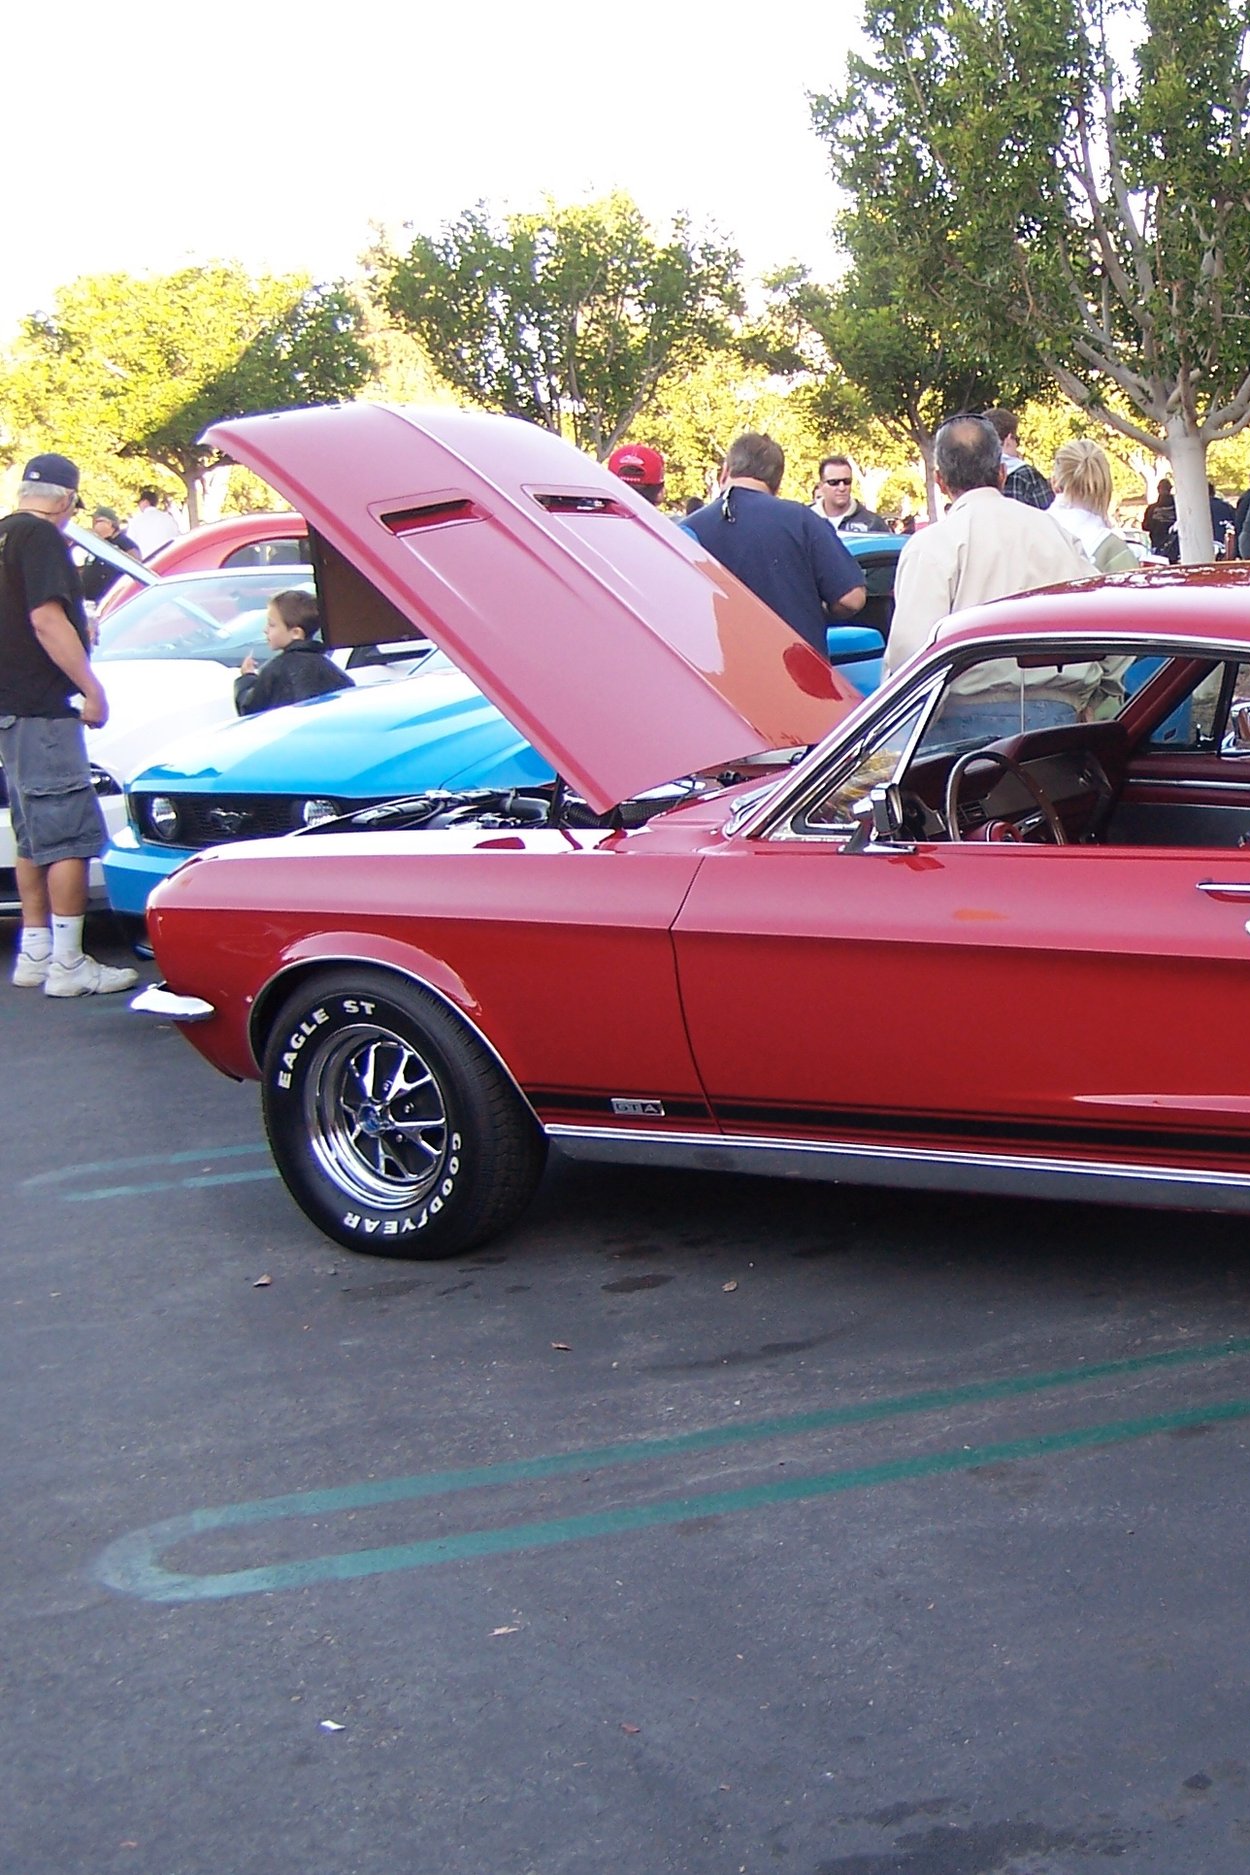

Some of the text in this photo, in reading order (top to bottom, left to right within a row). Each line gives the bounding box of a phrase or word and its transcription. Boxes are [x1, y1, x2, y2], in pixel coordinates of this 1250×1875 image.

[278, 1000, 376, 1089] EAGLE ST
[344, 1132, 462, 1235] GOODYEAR
